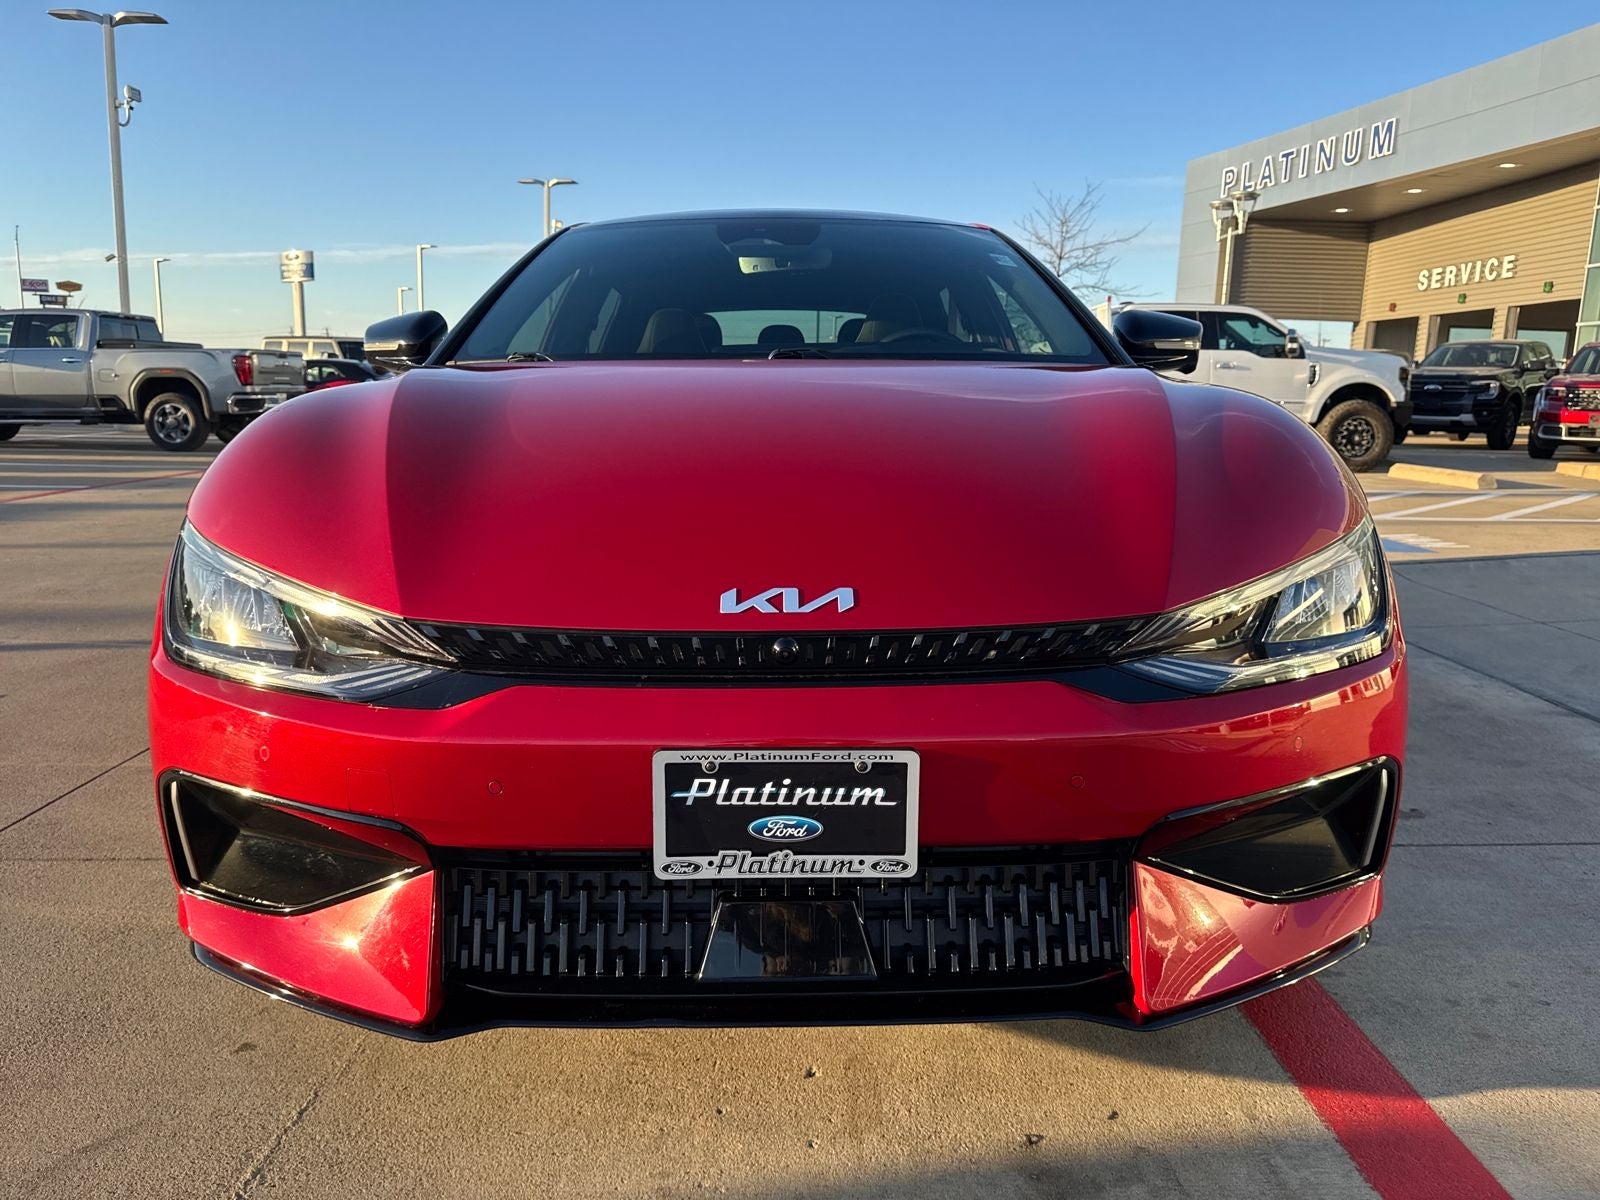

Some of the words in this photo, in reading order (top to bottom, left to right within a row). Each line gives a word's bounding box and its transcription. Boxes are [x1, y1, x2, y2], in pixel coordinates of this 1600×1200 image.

[1220, 117, 1397, 199] PLATINUM
[1417, 254, 1516, 291] SERVICE
[680, 752, 894, 761] www.PlatinumFord.com
[671, 778, 898, 806] Platinum
[762, 819, 808, 837] Ford
[667, 862, 696, 873] Ford
[715, 851, 864, 875] Platinum
[876, 860, 904, 872] Ford
